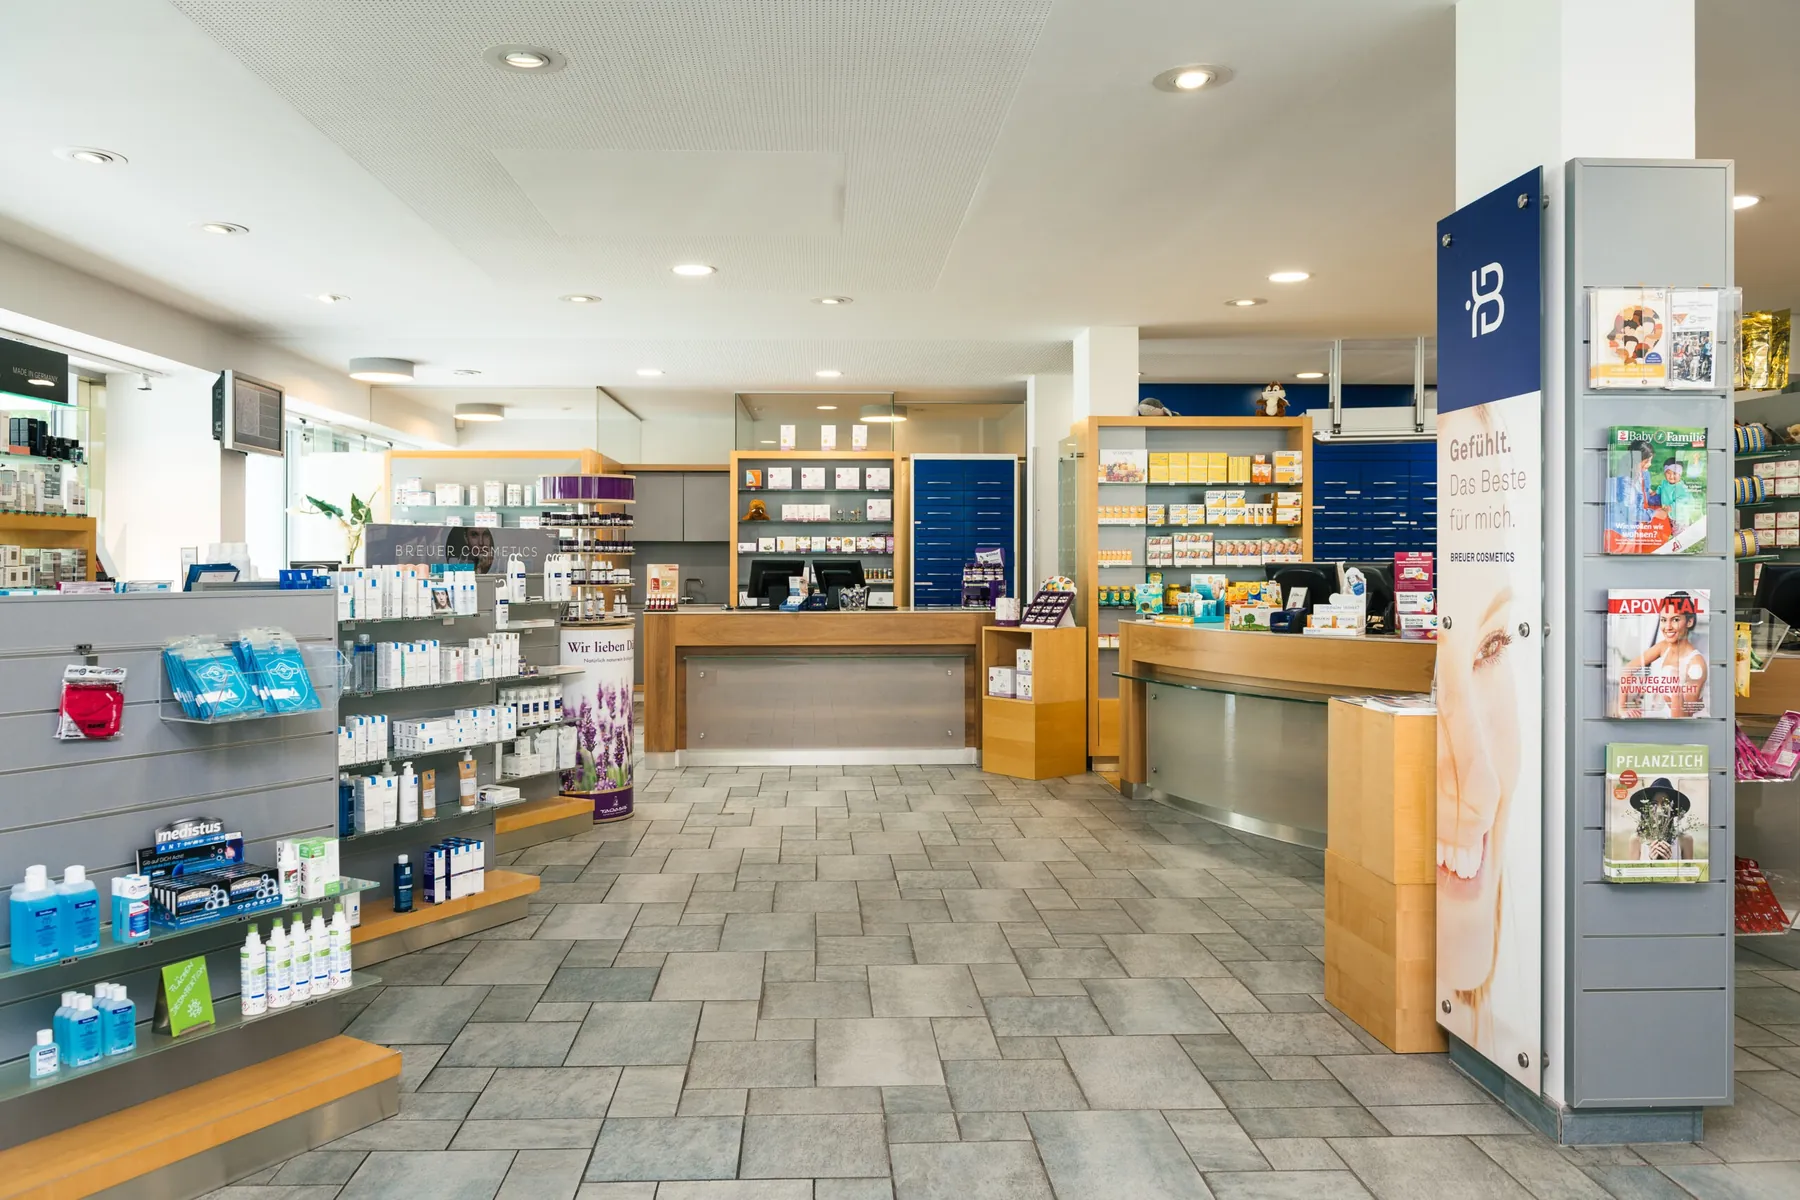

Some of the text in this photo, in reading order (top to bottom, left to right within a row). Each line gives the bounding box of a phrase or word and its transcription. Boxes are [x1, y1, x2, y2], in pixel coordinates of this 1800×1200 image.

[12, 366, 27, 377] MADE
[1629, 430, 1654, 444] Baby
[1666, 430, 1706, 442] Familie
[1449, 430, 1511, 462] Gefühlt.
[1450, 468, 1527, 497] Das Beste
[1449, 503, 1516, 531] für mich.
[395, 544, 538, 558] BREUER COSMETICS
[1450, 551, 1515, 563] BREUER COSMETICS
[1619, 598, 1705, 614] APOVITAL
[567, 641, 591, 653] Wir
[594, 640, 625, 653] lieben
[1620, 676, 1680, 685] DER WEG ZUM
[1620, 685, 1698, 694] WUNSCHGEWICHT
[1616, 754, 1704, 769] PFLANZLICH
[158, 821, 221, 843] medistus
